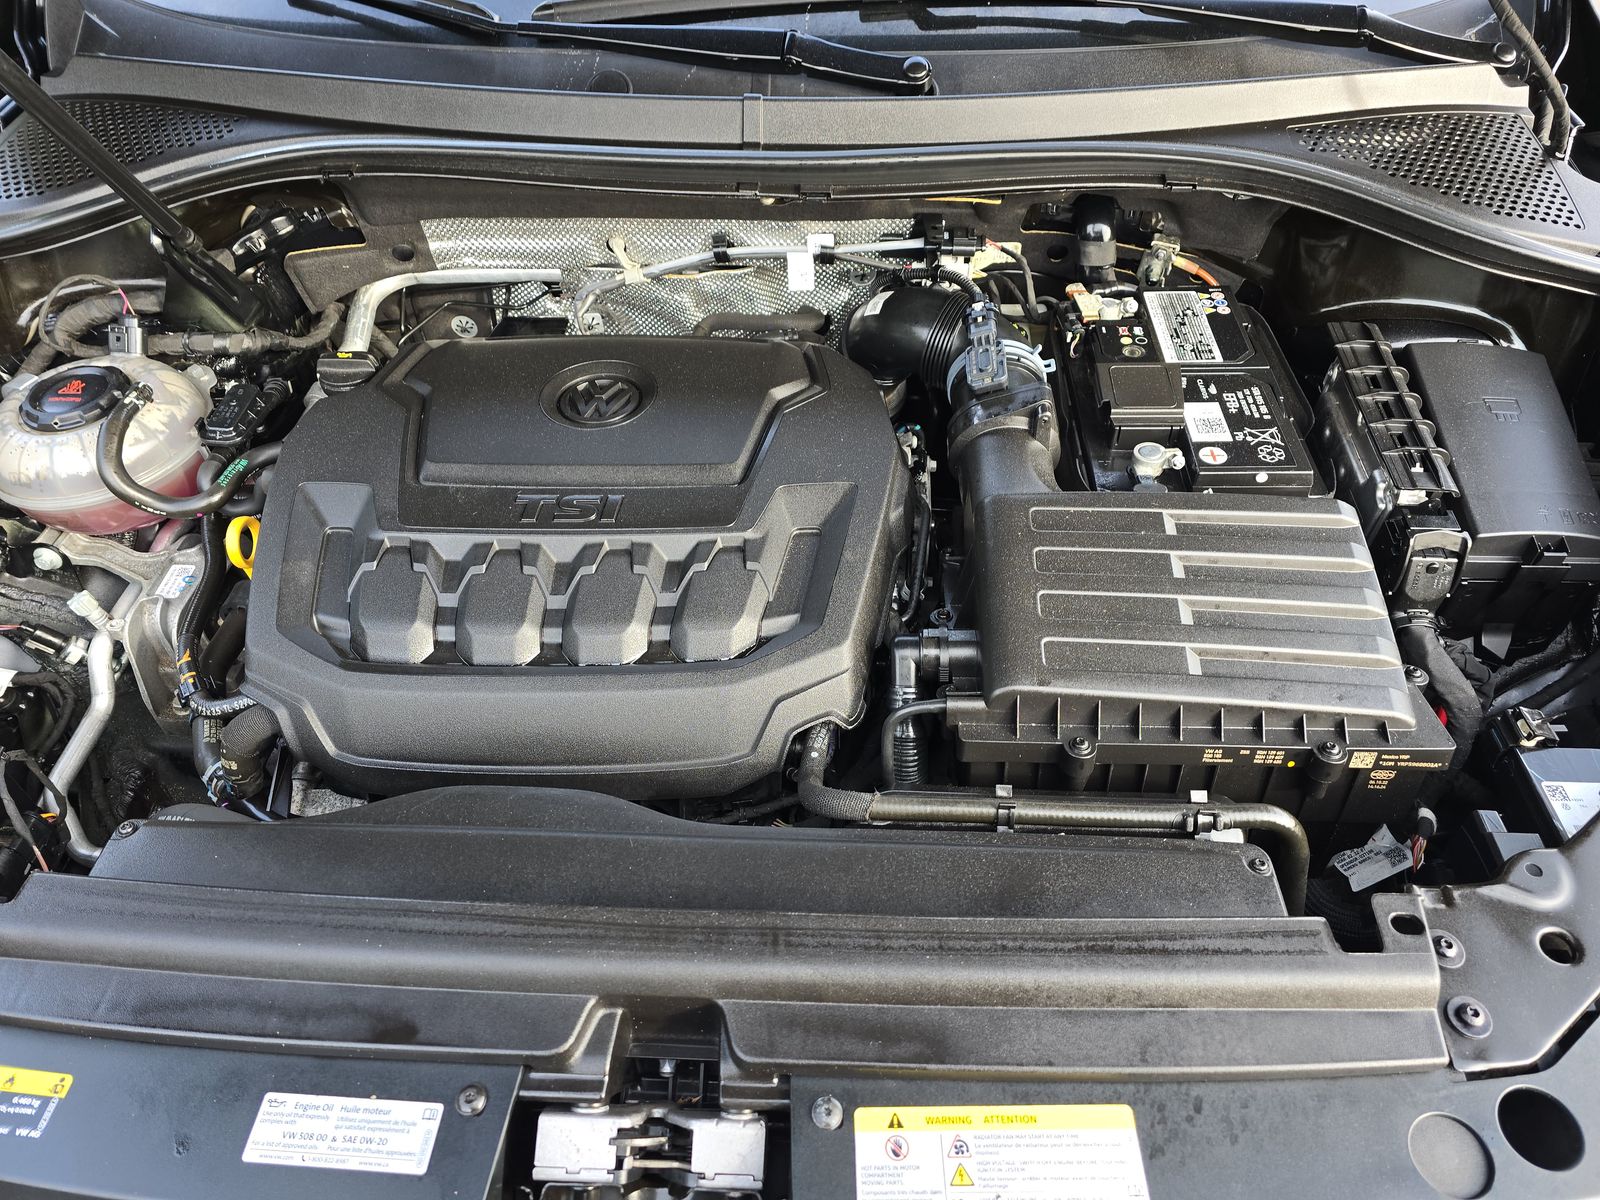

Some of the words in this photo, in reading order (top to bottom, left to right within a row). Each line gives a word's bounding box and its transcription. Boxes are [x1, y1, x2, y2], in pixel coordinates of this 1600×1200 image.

[1234, 432, 1245, 441] Pb
[516, 494, 624, 523] TSI
[294, 1102, 321, 1112] Engine
[322, 1103, 334, 1112] Oil
[339, 1104, 361, 1114] Huile
[362, 1107, 392, 1115] moteur
[925, 1116, 972, 1124] WARNING
[984, 1115, 1037, 1124] ATTENTION
[16, 1128, 29, 1136] VW
[282, 1131, 297, 1140] VW
[298, 1132, 314, 1140] 508
[316, 1133, 328, 1142] 00
[341, 1135, 358, 1144] SAE
[360, 1136, 388, 1146] 0W-20
